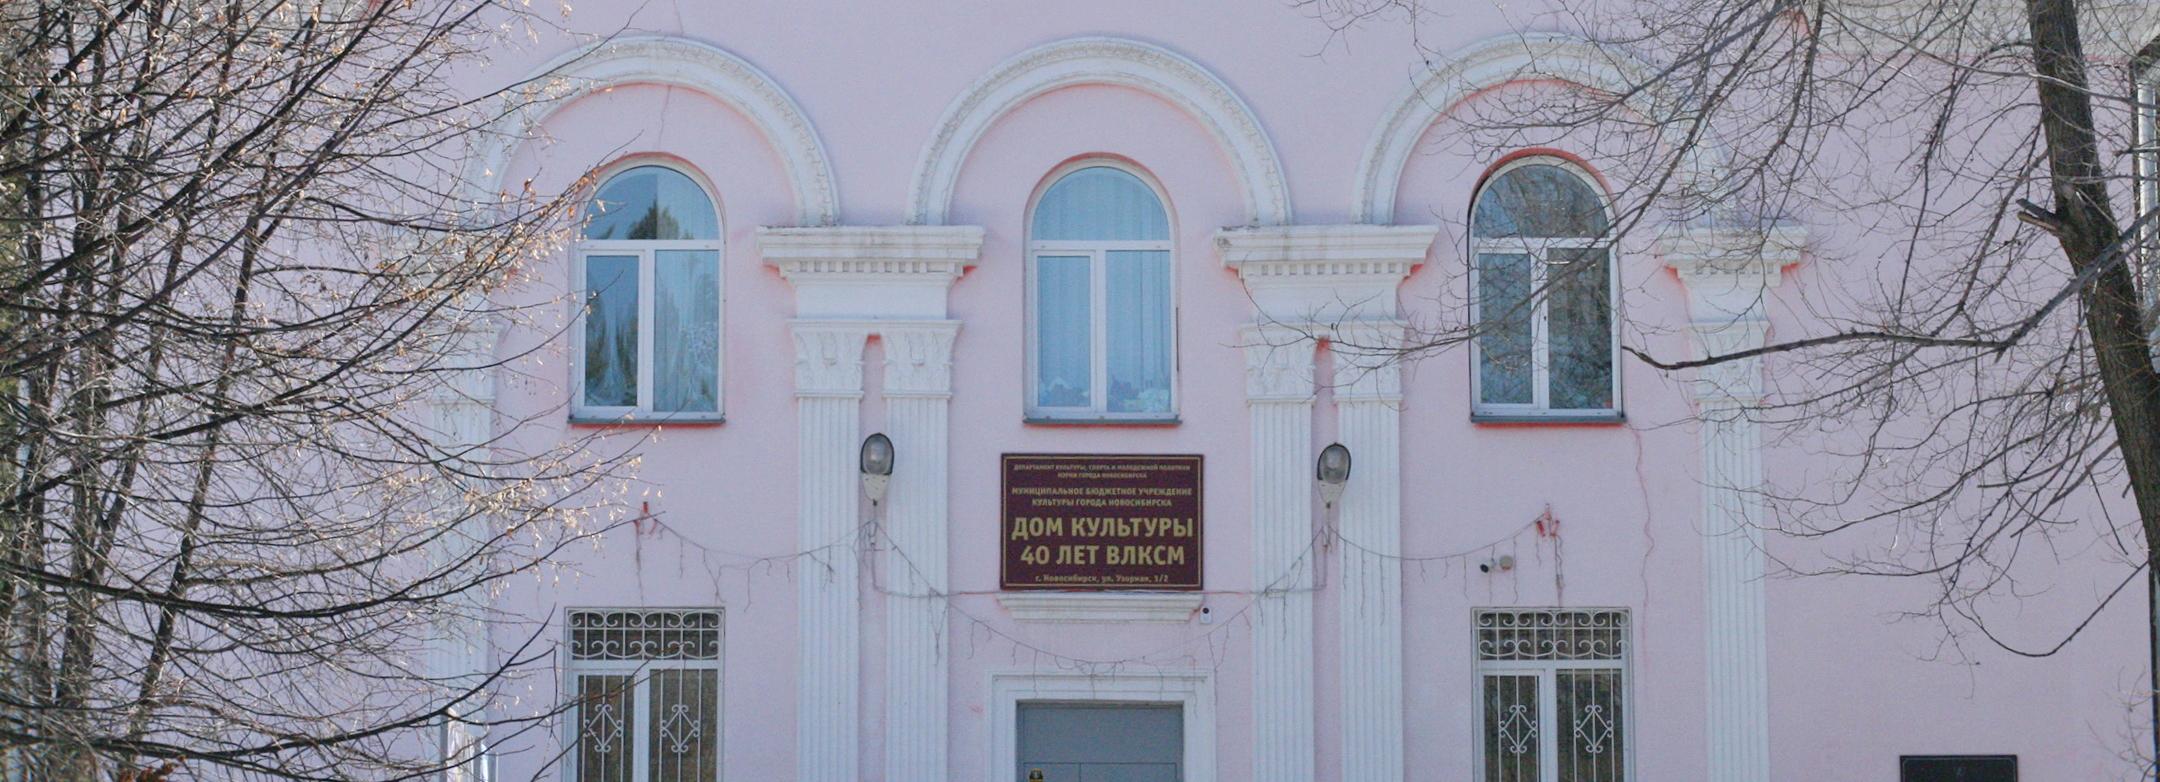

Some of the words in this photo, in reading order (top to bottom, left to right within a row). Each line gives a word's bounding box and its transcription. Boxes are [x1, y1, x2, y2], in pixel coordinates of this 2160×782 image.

[1012, 487, 1083, 496] МУНИЦИПАЛЬНОЕ
[1085, 487, 1136, 496] БЮДЖЕТНОЕ
[1138, 487, 1192, 496] УЧРЕЖДЕНИЕ
[1032, 498, 1074, 507] КУЛЬТУРЫ
[1075, 498, 1107, 508] ГОРОДА
[1108, 498, 1172, 507] НОВОСИБИРСКА
[1011, 517, 1063, 540] ДОМ
[1071, 517, 1193, 537] КУЛЬТУРЫ
[1020, 545, 1050, 565] 40
[1056, 545, 1099, 565] ЛЕТ
[1106, 545, 1185, 565] ВЛКСМ
[1043, 574, 1099, 584] Новосибирск,
[1101, 576, 1114, 584] ул.
[1154, 574, 1168, 583] 1/2
